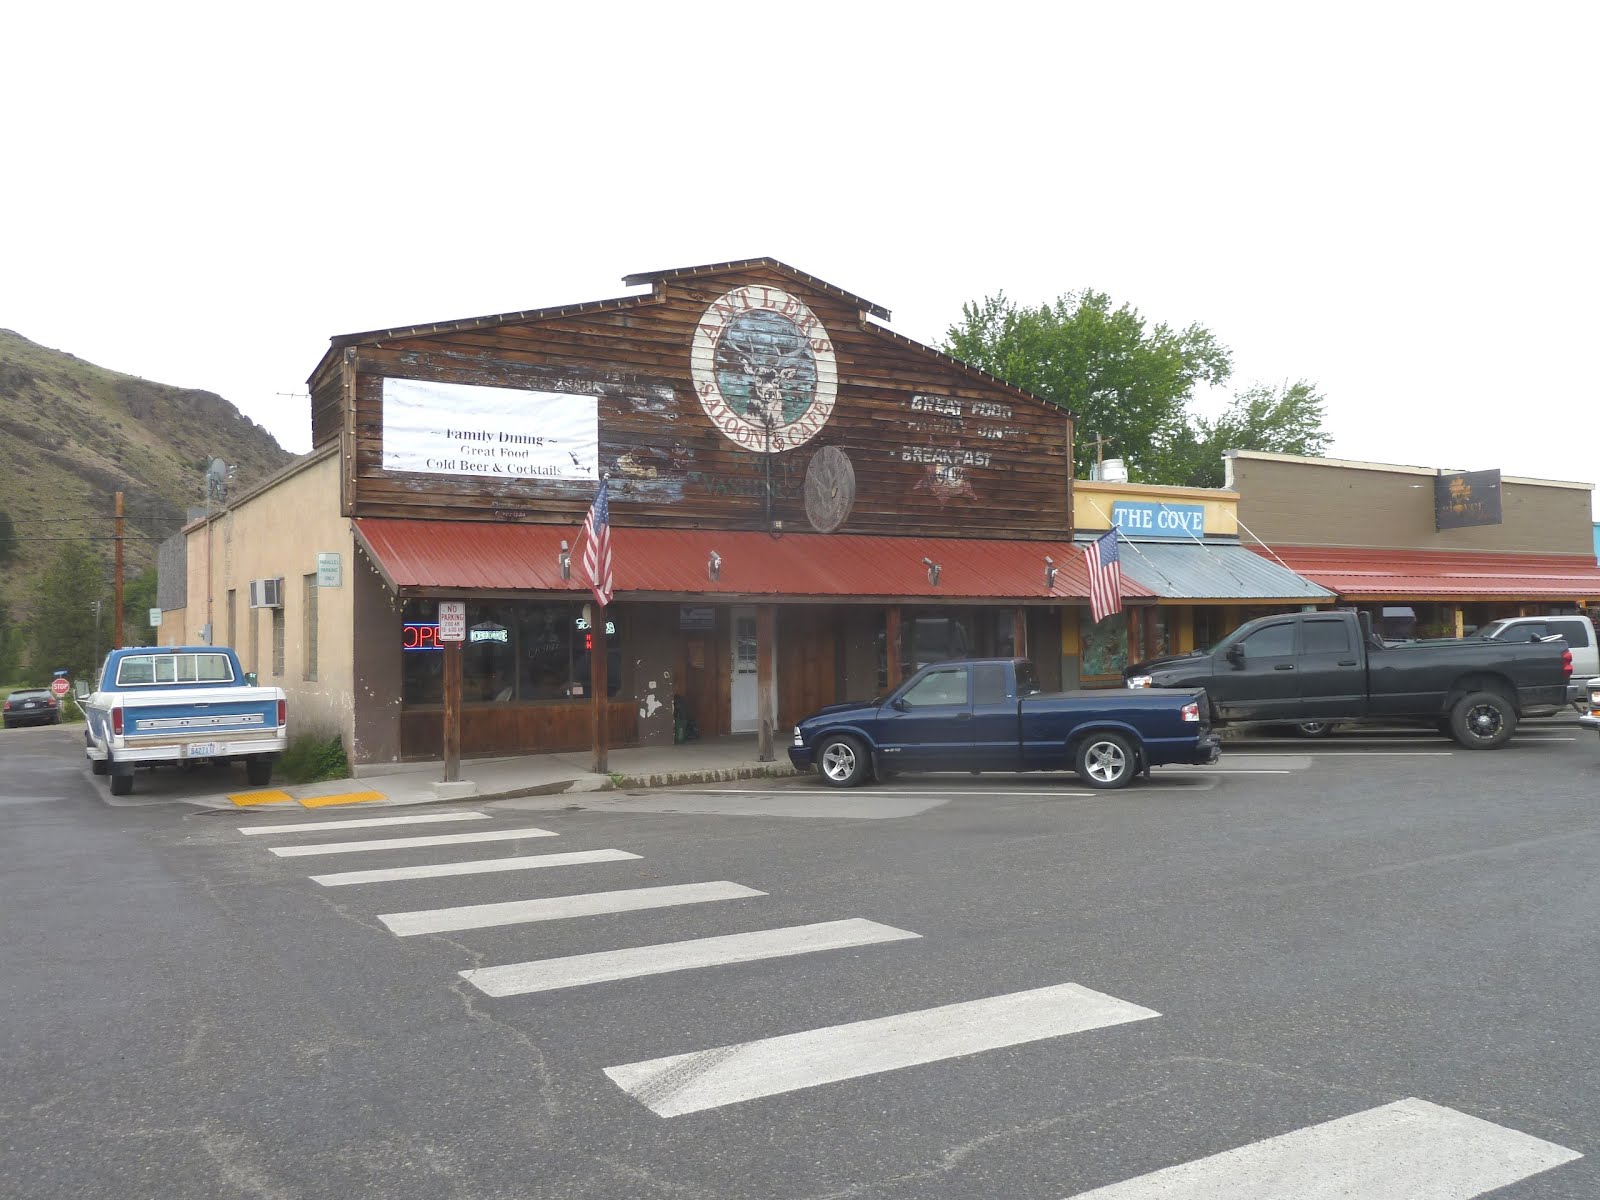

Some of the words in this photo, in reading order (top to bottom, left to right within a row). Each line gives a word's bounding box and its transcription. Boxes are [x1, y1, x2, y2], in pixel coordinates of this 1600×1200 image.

[699, 288, 833, 353] ANTLERS
[700, 383, 762, 449] SALOON
[787, 401, 830, 446] CAFE
[911, 395, 963, 417] GREAT
[971, 402, 1012, 419] FOOD
[446, 428, 495, 444] Family
[499, 431, 545, 446] Dining
[460, 445, 495, 457] Great
[500, 447, 529, 458] Food
[902, 445, 993, 467] BREAKFAST
[426, 459, 456, 470] Cold
[460, 460, 489, 472] Beer
[492, 463, 503, 473] &
[507, 464, 562, 476] Cocktails
[1114, 508, 1153, 529] THE
[1157, 511, 1203, 530] COVE
[441, 613, 464, 621] PARKING
[447, 605, 458, 613] NO
